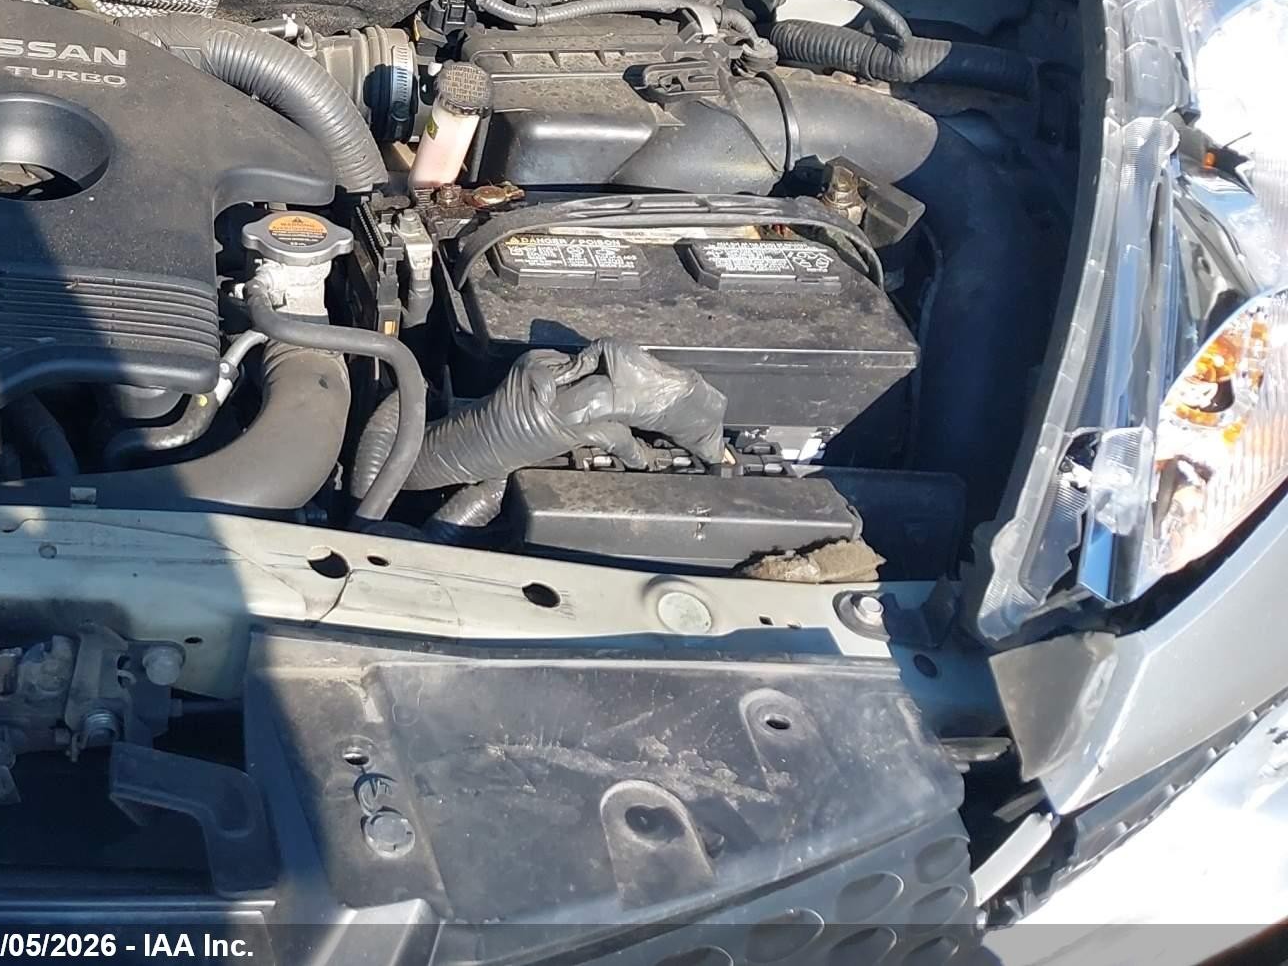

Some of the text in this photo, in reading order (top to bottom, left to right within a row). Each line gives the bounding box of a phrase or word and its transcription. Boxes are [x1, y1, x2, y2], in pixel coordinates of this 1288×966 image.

[6, 65, 126, 86] TURBO
[520, 237, 567, 245] DANGER
[578, 238, 621, 247] POISON
